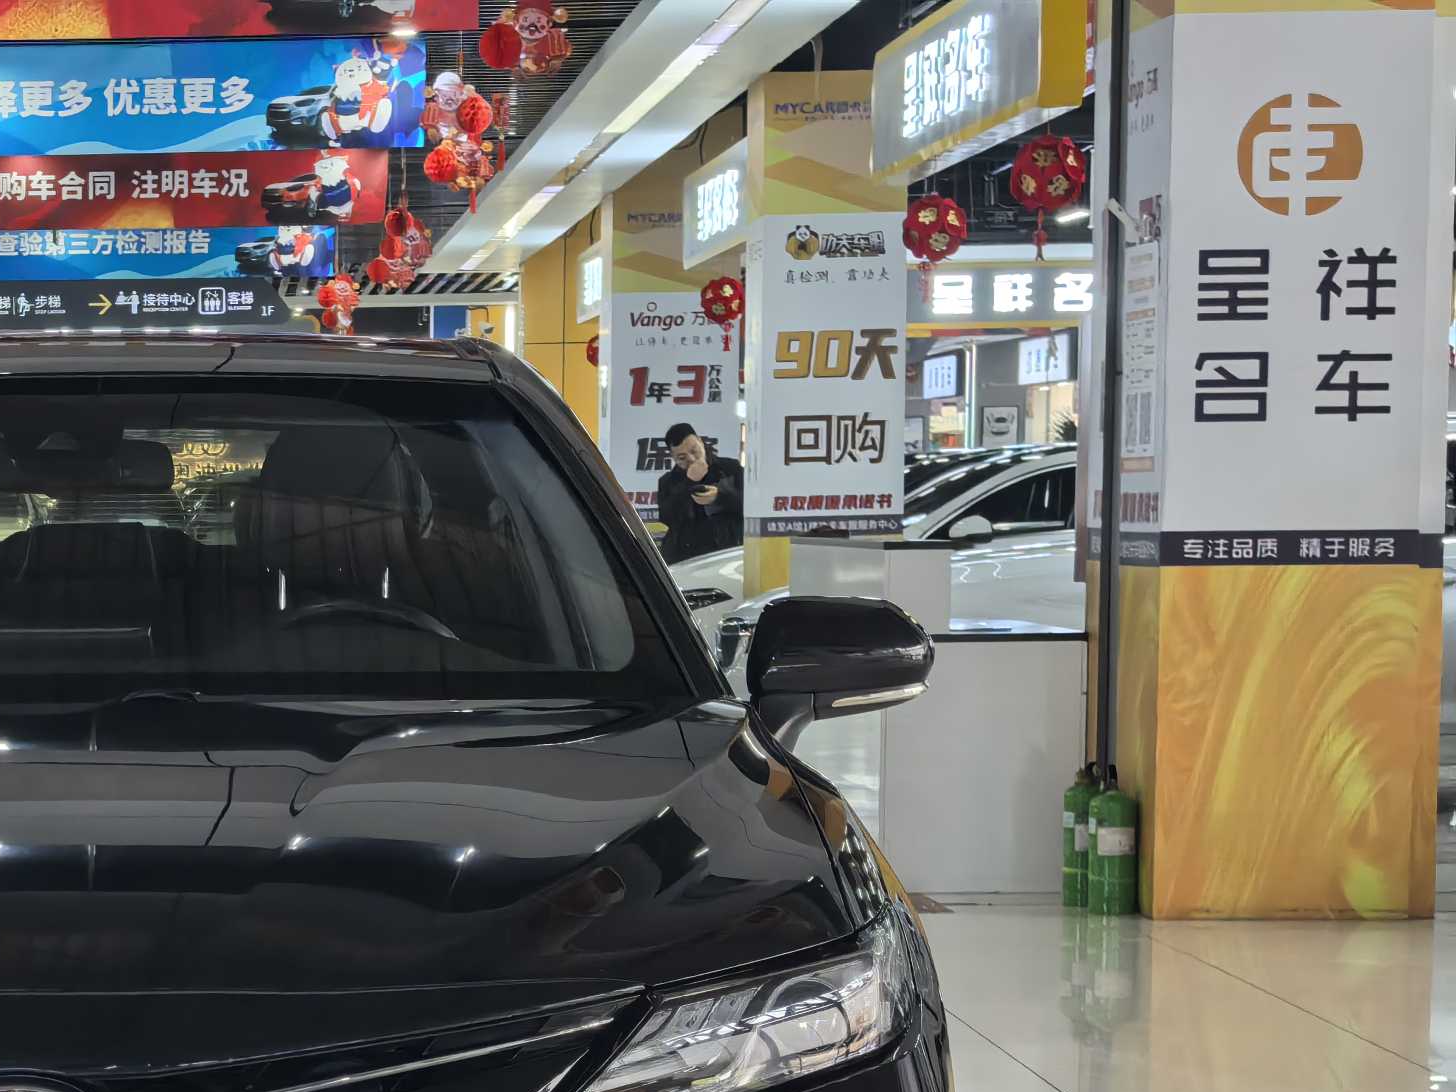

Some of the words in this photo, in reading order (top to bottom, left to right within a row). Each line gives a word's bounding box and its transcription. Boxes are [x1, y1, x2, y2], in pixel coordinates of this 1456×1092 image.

[103, 75, 256, 117] 优惠更多
[131, 168, 250, 199] 注明车况
[34, 295, 62, 309] 步梯
[142, 292, 196, 307] 接待中心
[227, 291, 254, 305] 客梯
[1196, 247, 1398, 321] 呈祥
[260, 306, 275, 317] 1F
[630, 311, 684, 331] Vango
[773, 328, 899, 380] 90天
[1193, 349, 1393, 422] 名车
[784, 412, 889, 466] 回购
[1182, 538, 1279, 559] 专注品质
[1298, 537, 1396, 559] 精于服务
